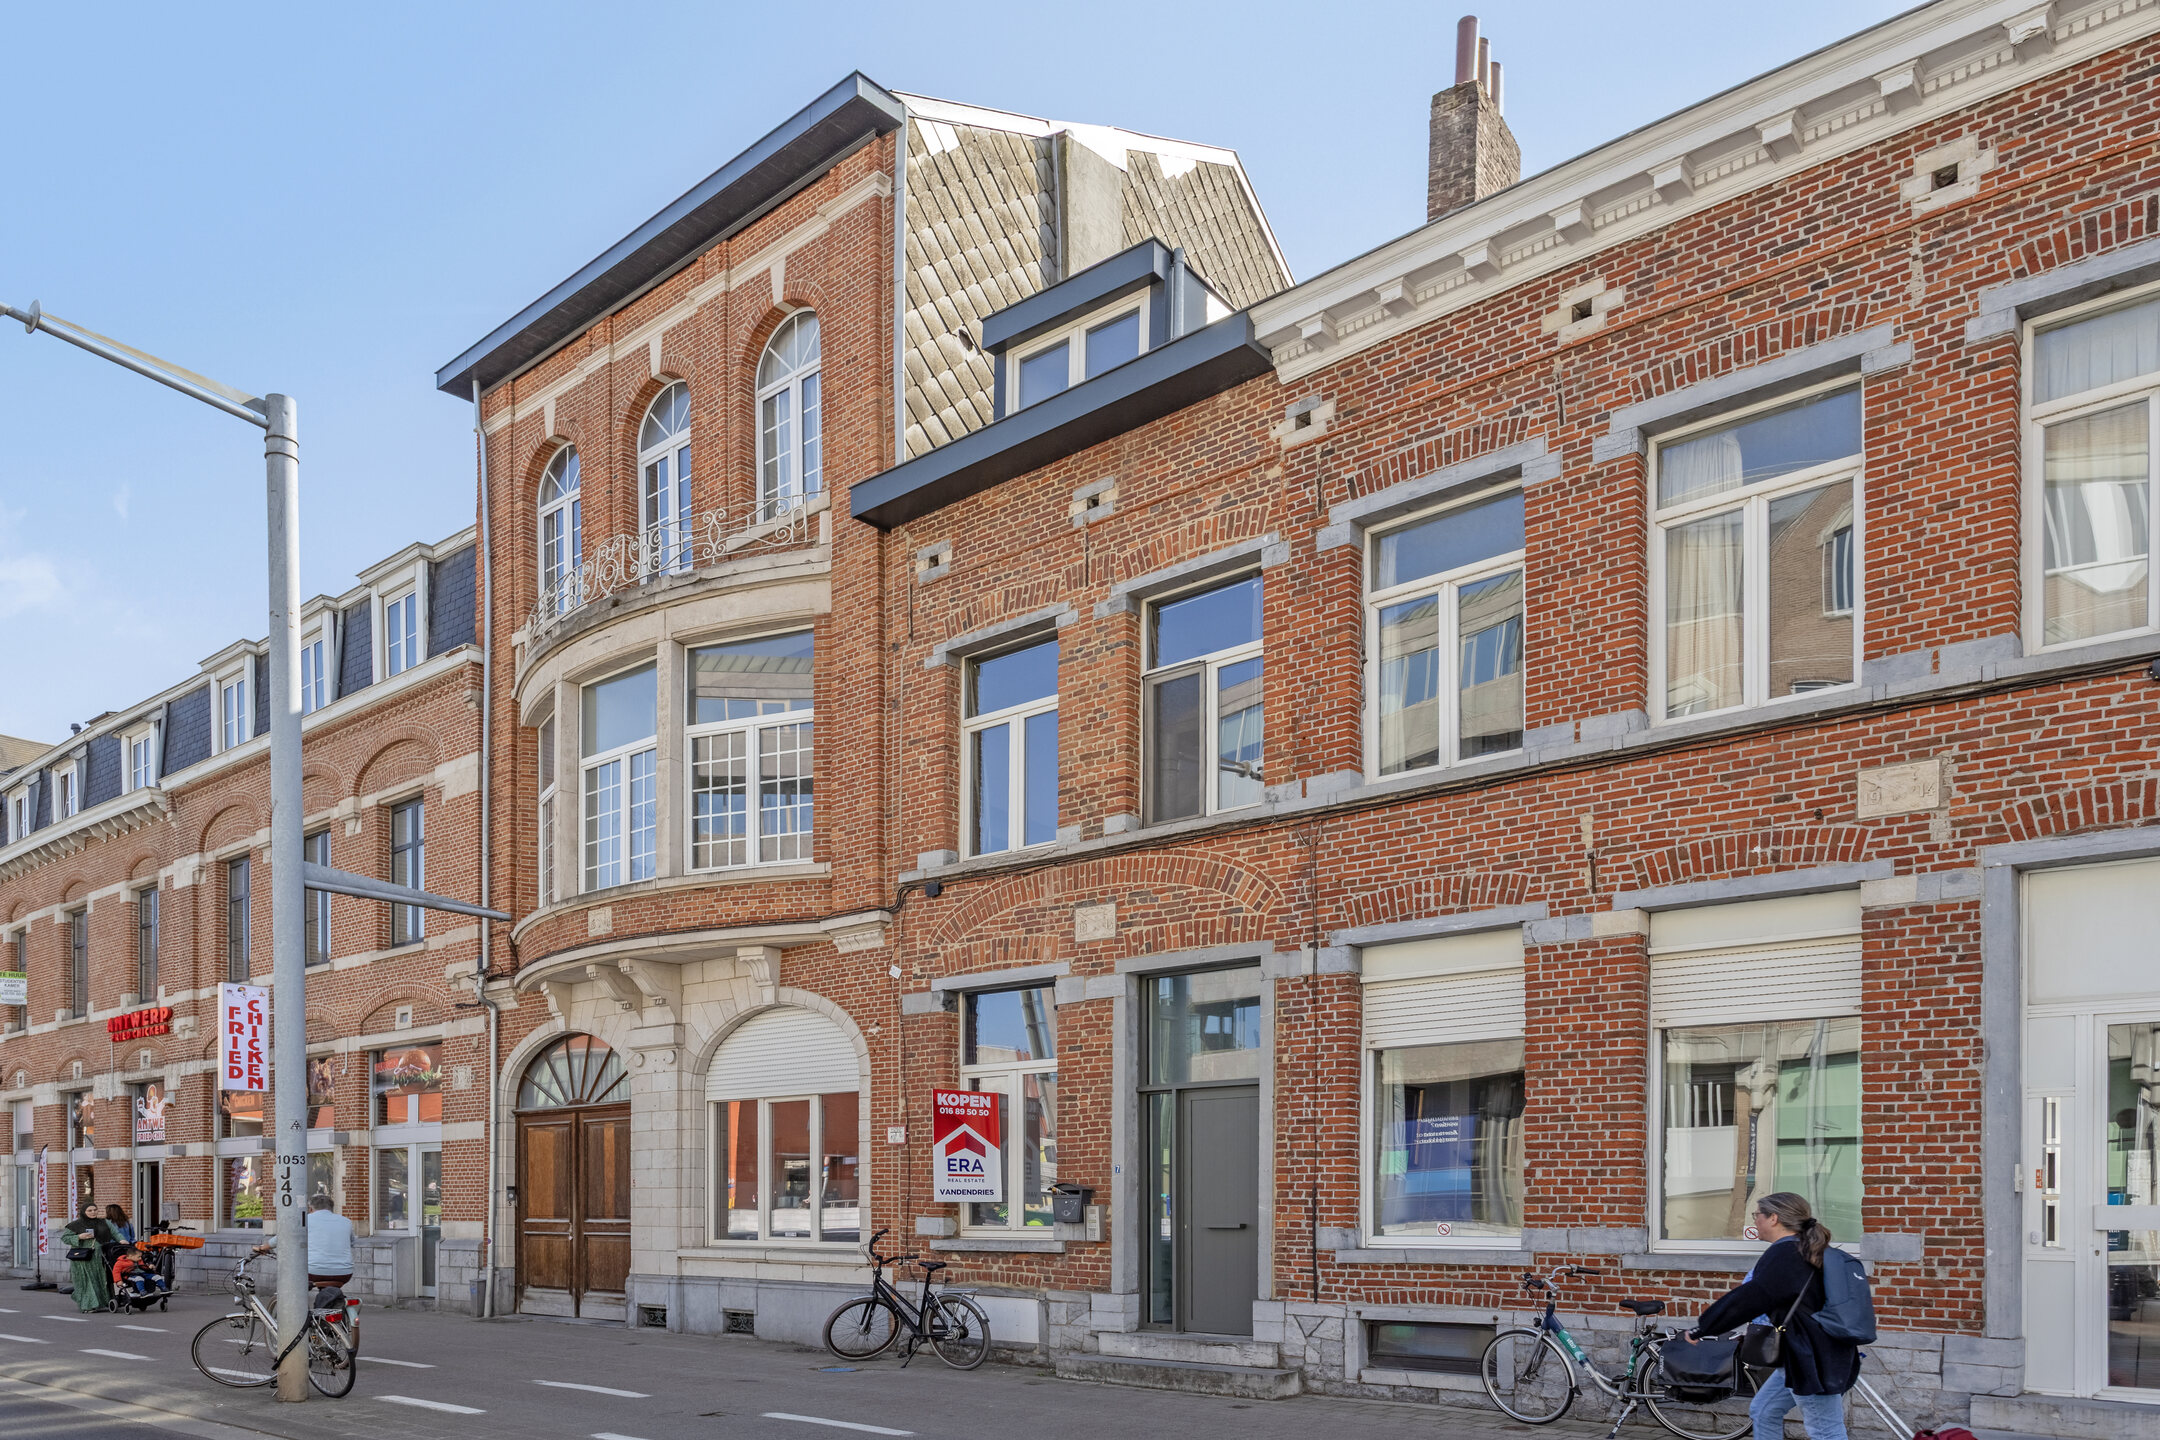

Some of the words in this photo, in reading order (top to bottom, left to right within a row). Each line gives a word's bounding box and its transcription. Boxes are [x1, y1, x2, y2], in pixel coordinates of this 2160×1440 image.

[107, 1006, 171, 1033] ANTWERP
[112, 1030, 131, 1042] FRIED
[132, 1023, 166, 1039] CHICKEN
[228, 1006, 244, 1079] FRIED
[247, 1000, 264, 1090] CHICKEN
[937, 1093, 991, 1108] KOPEN
[939, 1107, 954, 1115] 016
[955, 1108, 966, 1116] 89
[966, 1108, 978, 1117] 50
[978, 1109, 990, 1117] 50
[137, 1132, 152, 1141] FRIED
[277, 1155, 306, 1165] 1053
[947, 1158, 984, 1173] ERA
[939, 1188, 995, 1196] VANDENDRIES
